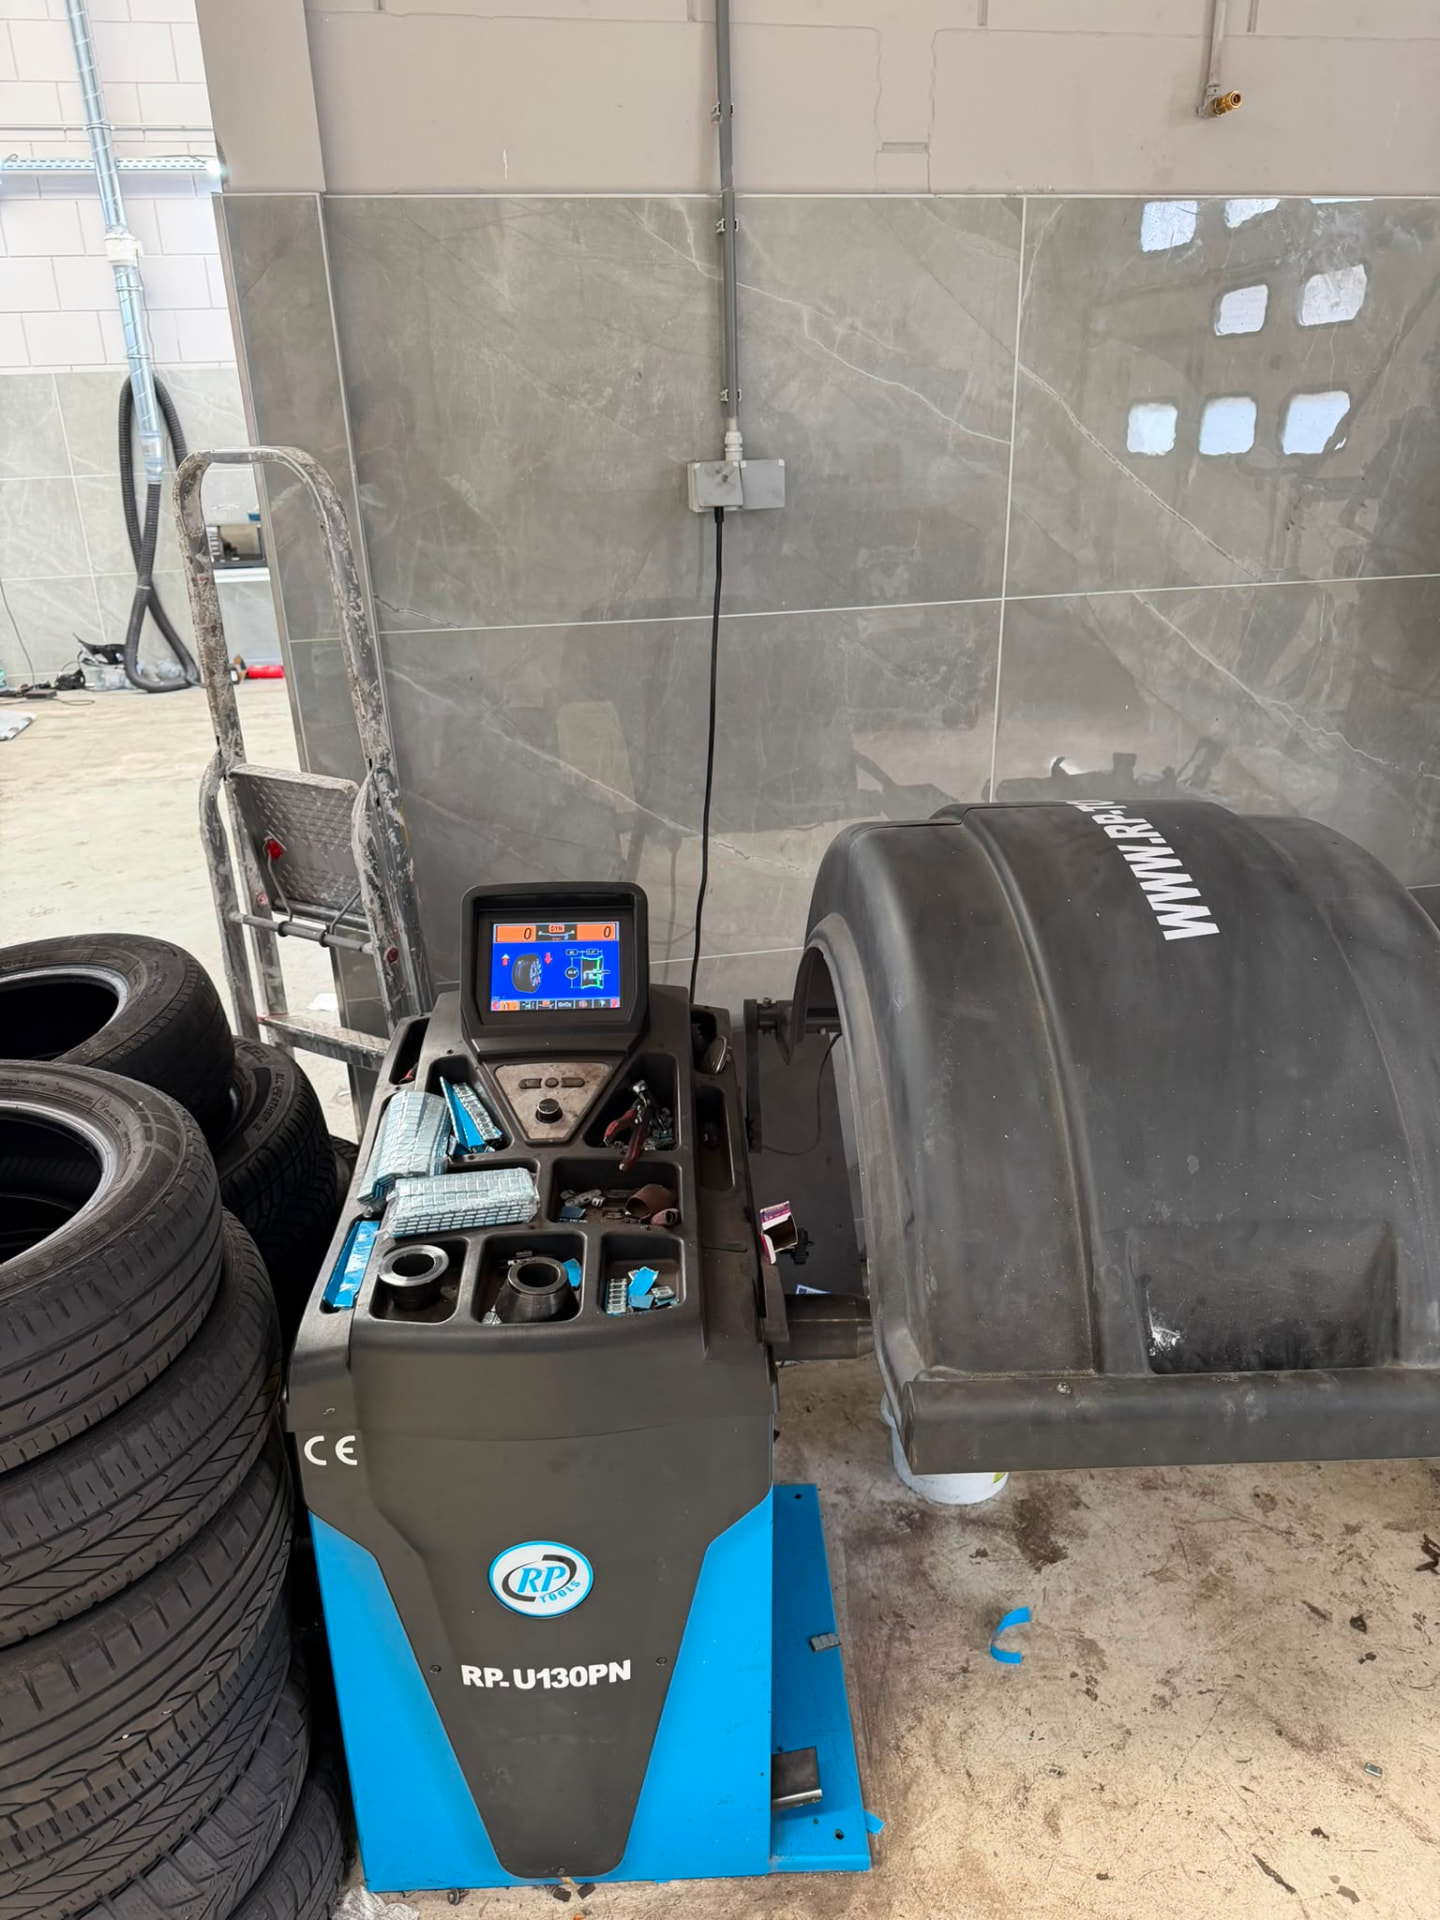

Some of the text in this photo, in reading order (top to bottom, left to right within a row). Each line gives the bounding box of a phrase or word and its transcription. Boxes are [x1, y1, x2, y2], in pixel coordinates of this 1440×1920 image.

[523, 927, 532, 940] 0
[603, 925, 612, 938] 0
[304, 1435, 358, 1466] CE
[517, 1566, 567, 1593] RP
[539, 1579, 581, 1604] TOOLS
